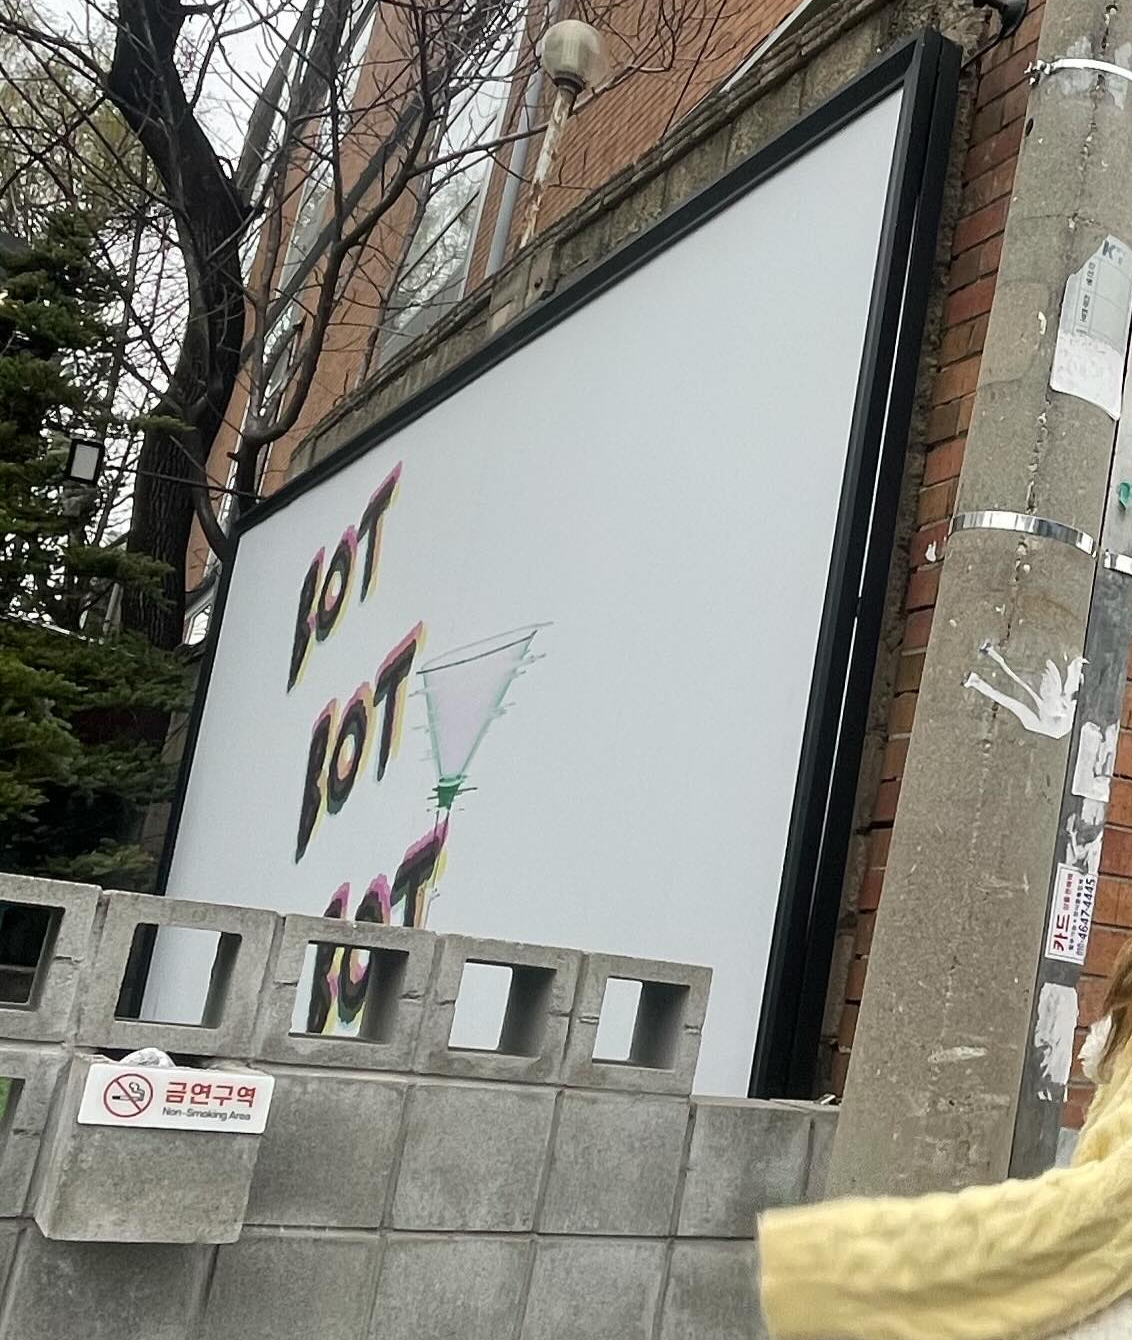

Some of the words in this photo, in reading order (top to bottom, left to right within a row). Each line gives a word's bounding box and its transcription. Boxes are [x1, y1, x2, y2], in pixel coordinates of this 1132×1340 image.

[1053, 913, 1071, 952] 카드
[165, 1081, 257, 1108] 금연구역
[162, 1106, 227, 1121] Non-Smoking
[228, 1110, 251, 1121] Area
